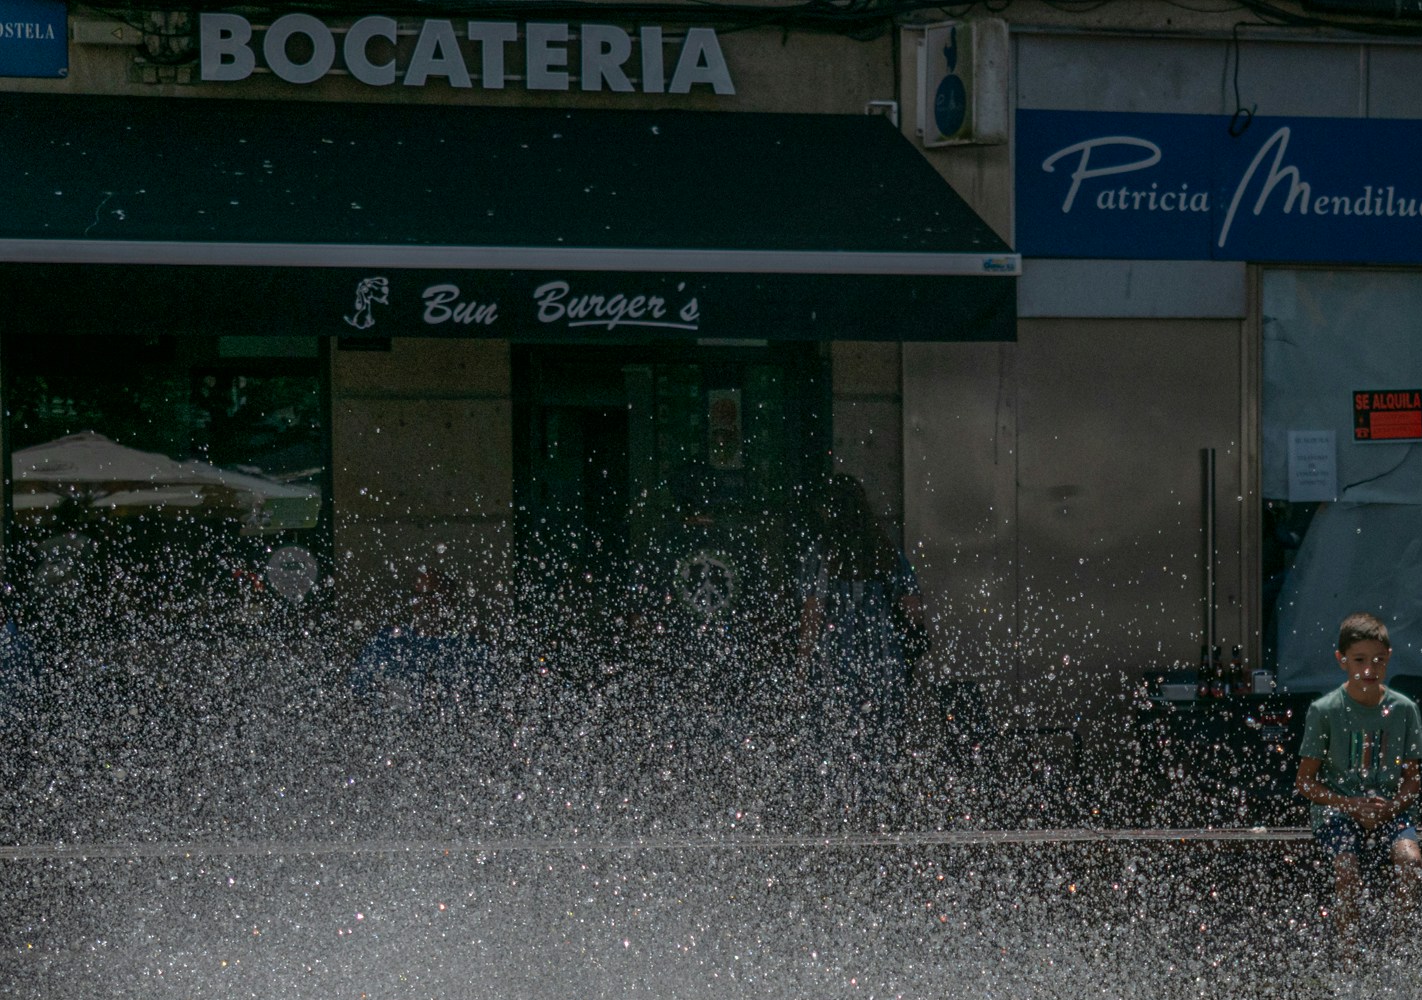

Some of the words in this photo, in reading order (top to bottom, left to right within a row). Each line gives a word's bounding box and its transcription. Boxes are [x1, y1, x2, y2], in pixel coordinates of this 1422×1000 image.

[201, 13, 735, 95] BOCATERIA
[1042, 136, 1210, 213] Patricia
[421, 284, 498, 325] Bun
[533, 280, 700, 331] Burger's
[1355, 393, 1369, 410] SE
[1372, 391, 1421, 409] ALQUILA
